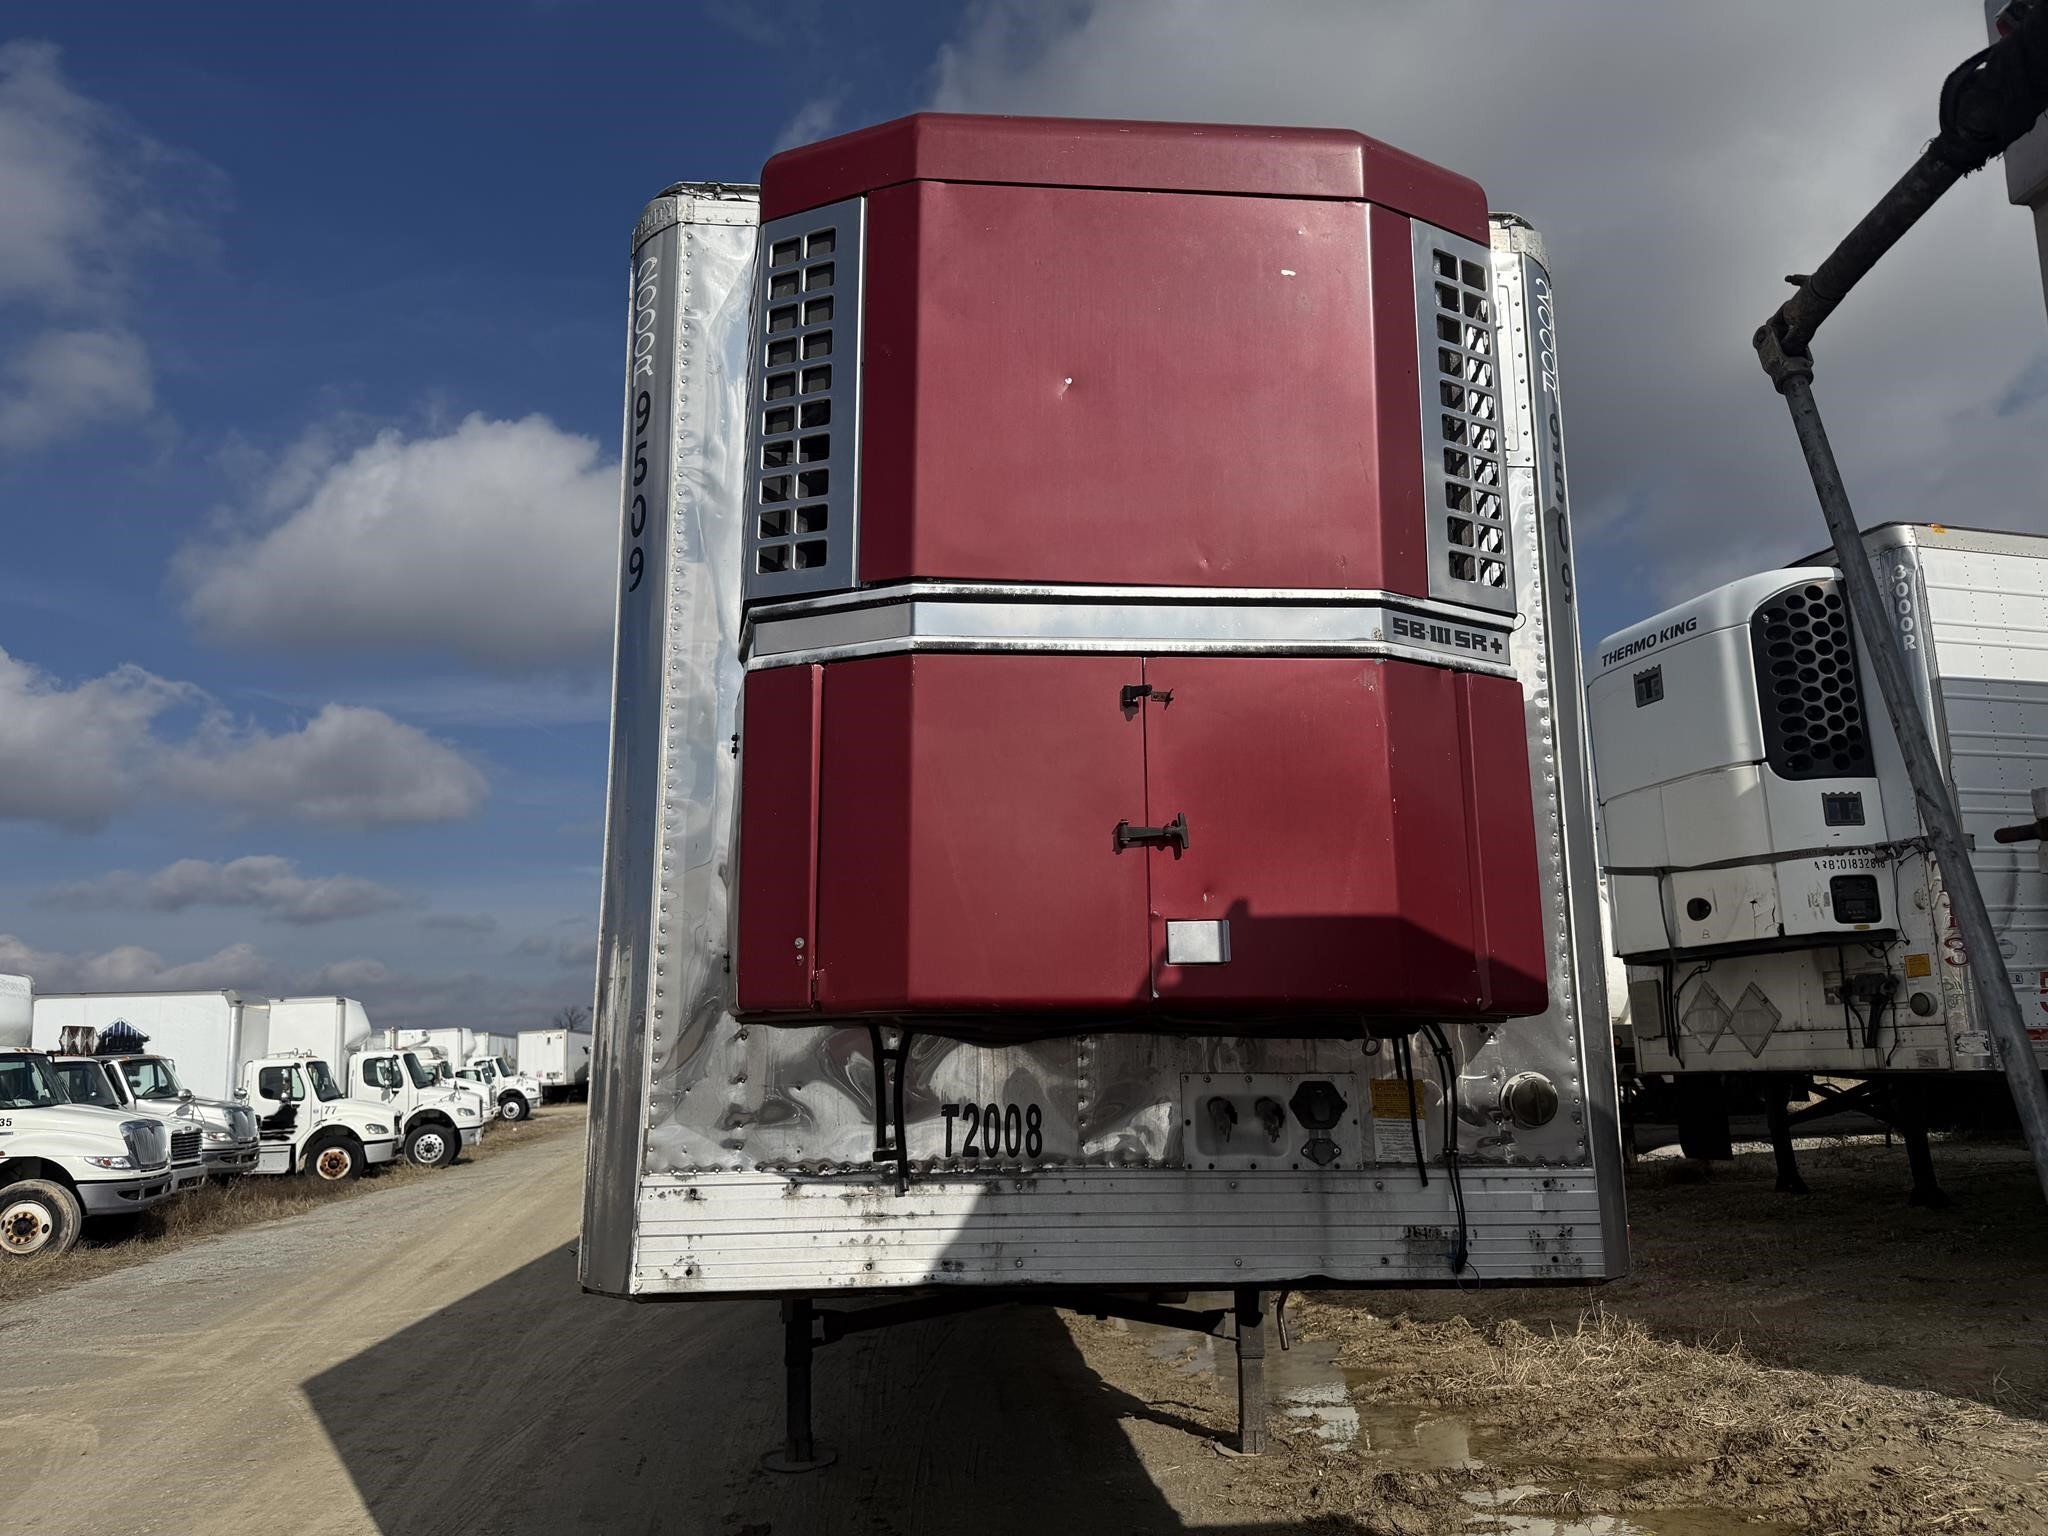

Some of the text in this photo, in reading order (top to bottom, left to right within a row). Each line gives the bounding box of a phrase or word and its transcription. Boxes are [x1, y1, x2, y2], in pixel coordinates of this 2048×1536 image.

[628, 256, 658, 594] 2000R 9509
[1549, 413, 1571, 606] 9509
[1601, 616, 1697, 668] THERMO KING
[325, 1105, 337, 1114] 77
[942, 1103, 1043, 1158] T2008
